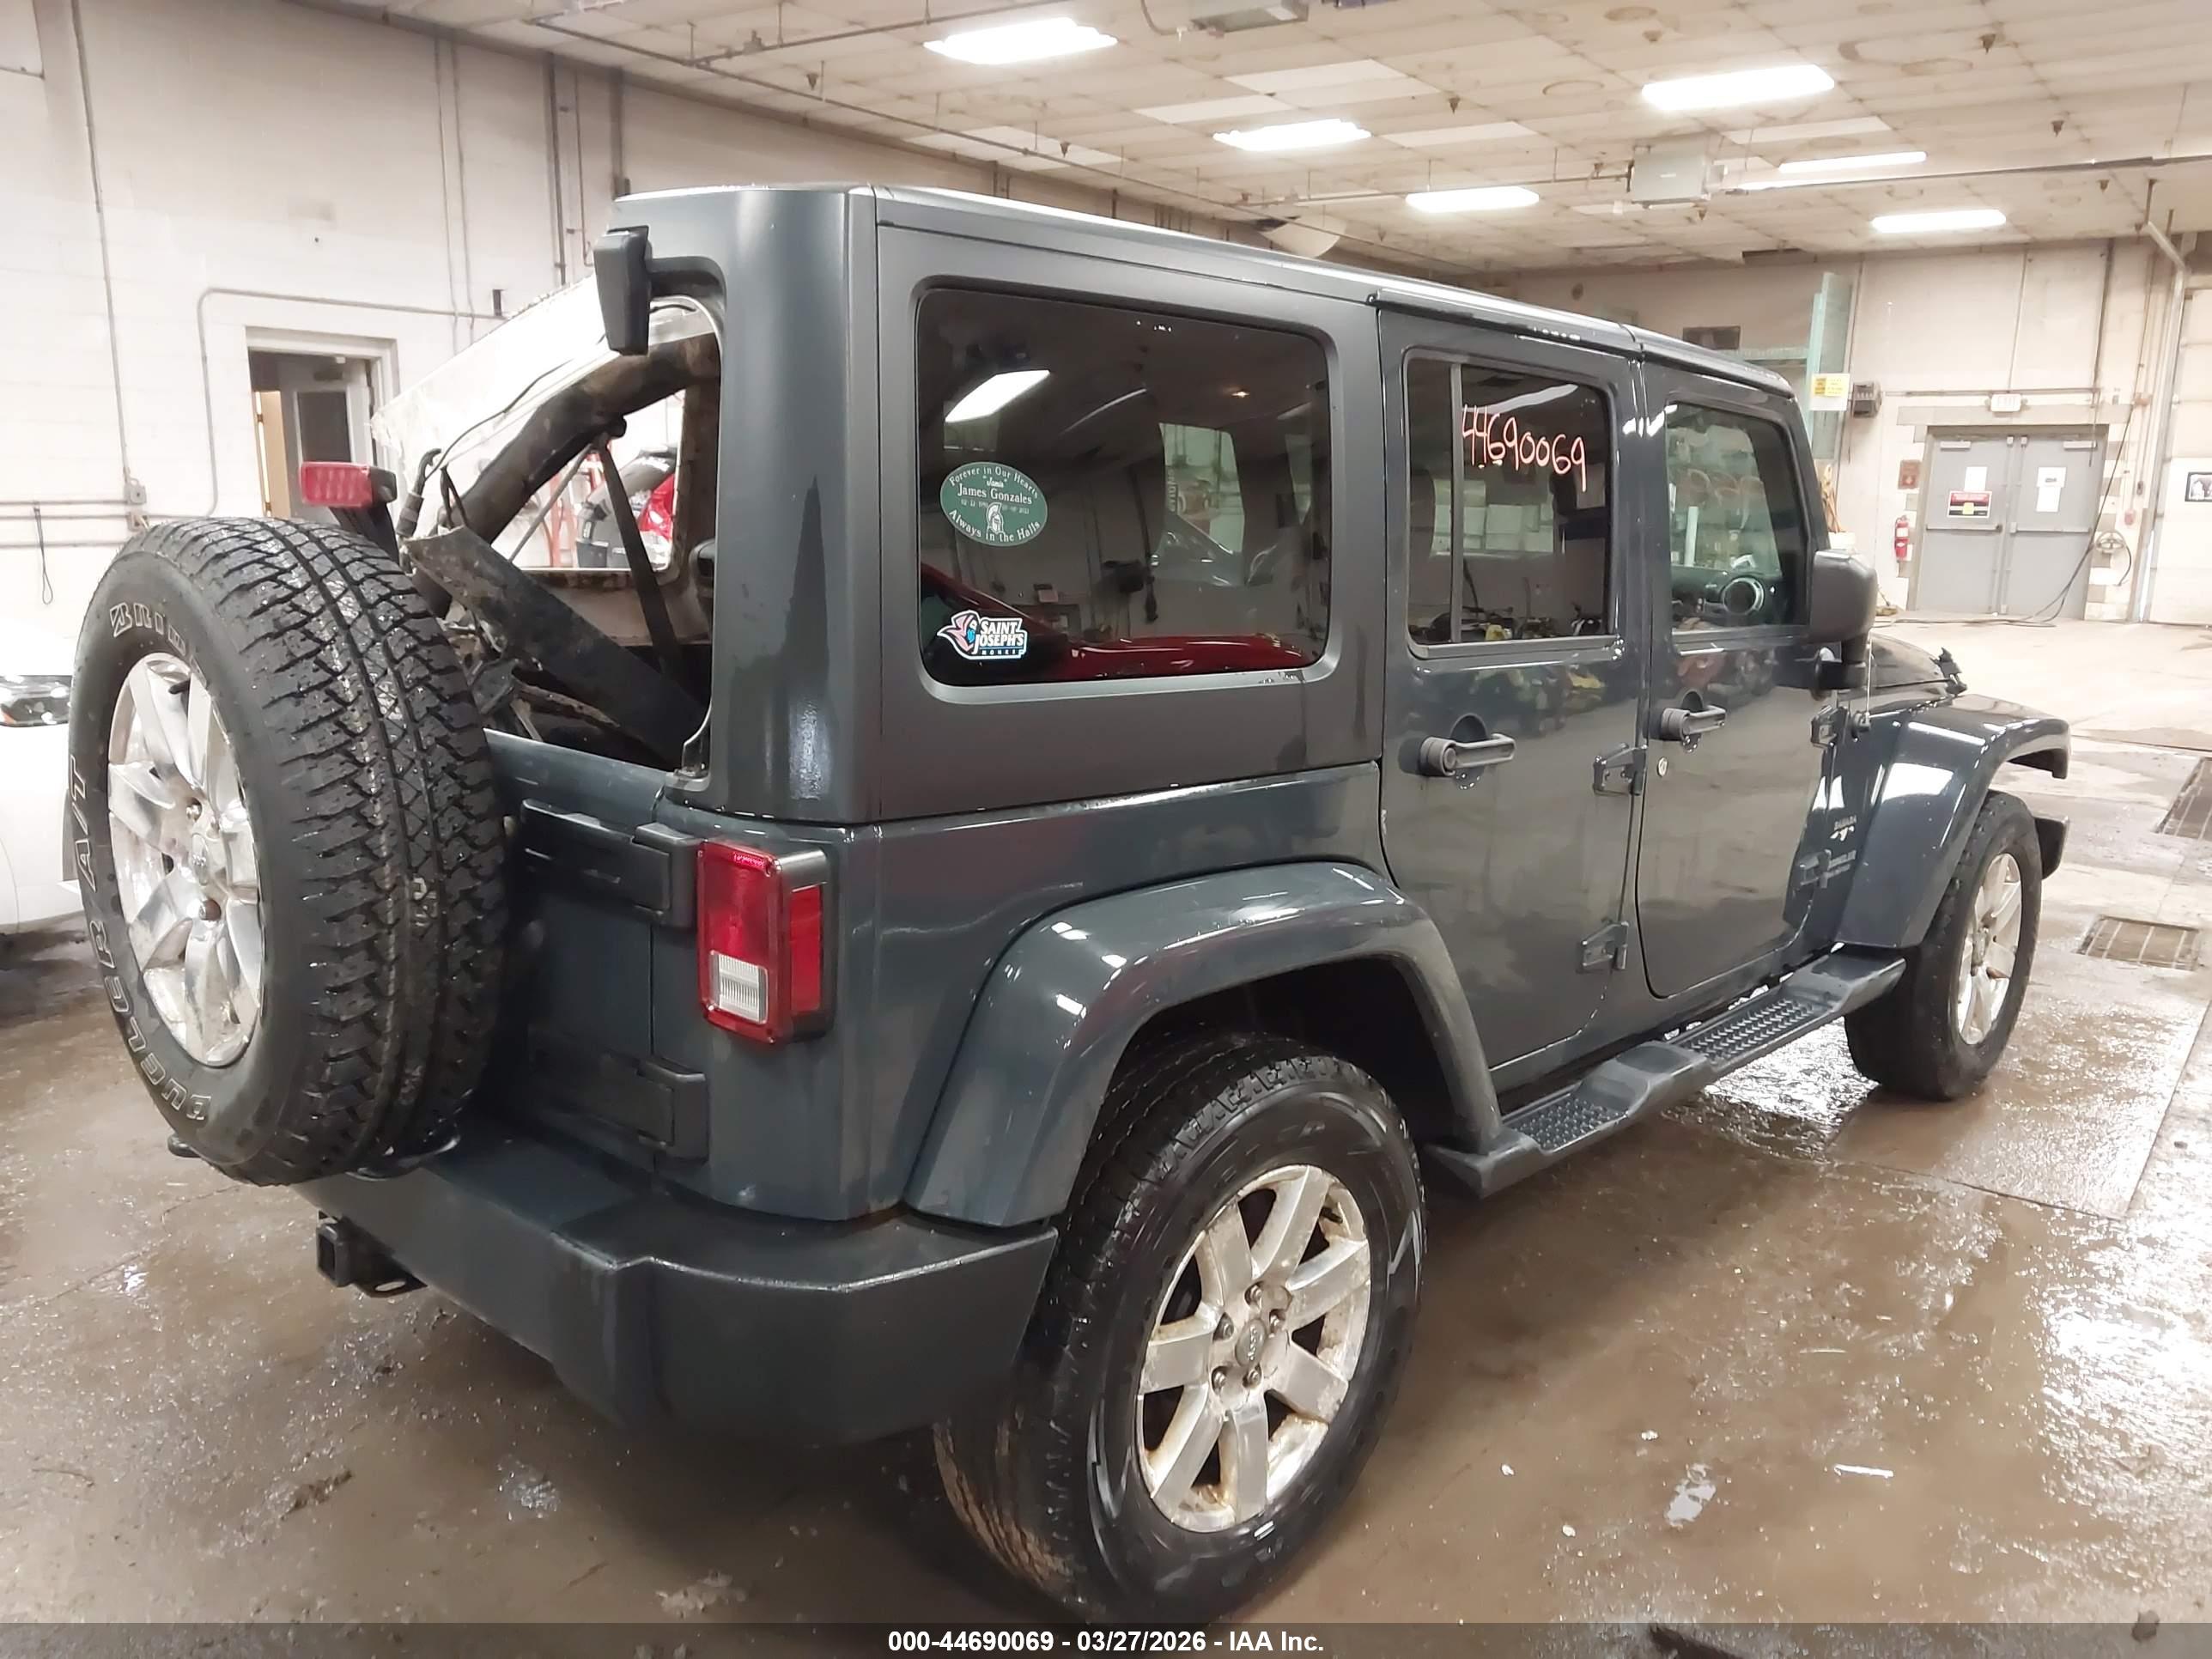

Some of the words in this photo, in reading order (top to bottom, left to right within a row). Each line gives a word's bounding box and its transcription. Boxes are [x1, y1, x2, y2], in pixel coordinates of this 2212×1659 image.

[1462, 404, 1587, 492] 44690069
[950, 467, 980, 486] Forever
[983, 466, 992, 475] in
[995, 466, 1012, 478] Our
[1014, 472, 1038, 499] Hearts
[957, 483, 988, 498] James
[991, 488, 1032, 505] Gonzales
[949, 509, 981, 538] Always
[986, 532, 995, 542] in
[1000, 532, 1015, 543] the
[1017, 521, 1041, 541] Halls
[980, 620, 1018, 635] SAINT
[971, 634, 1024, 654] JOSEPH'S
